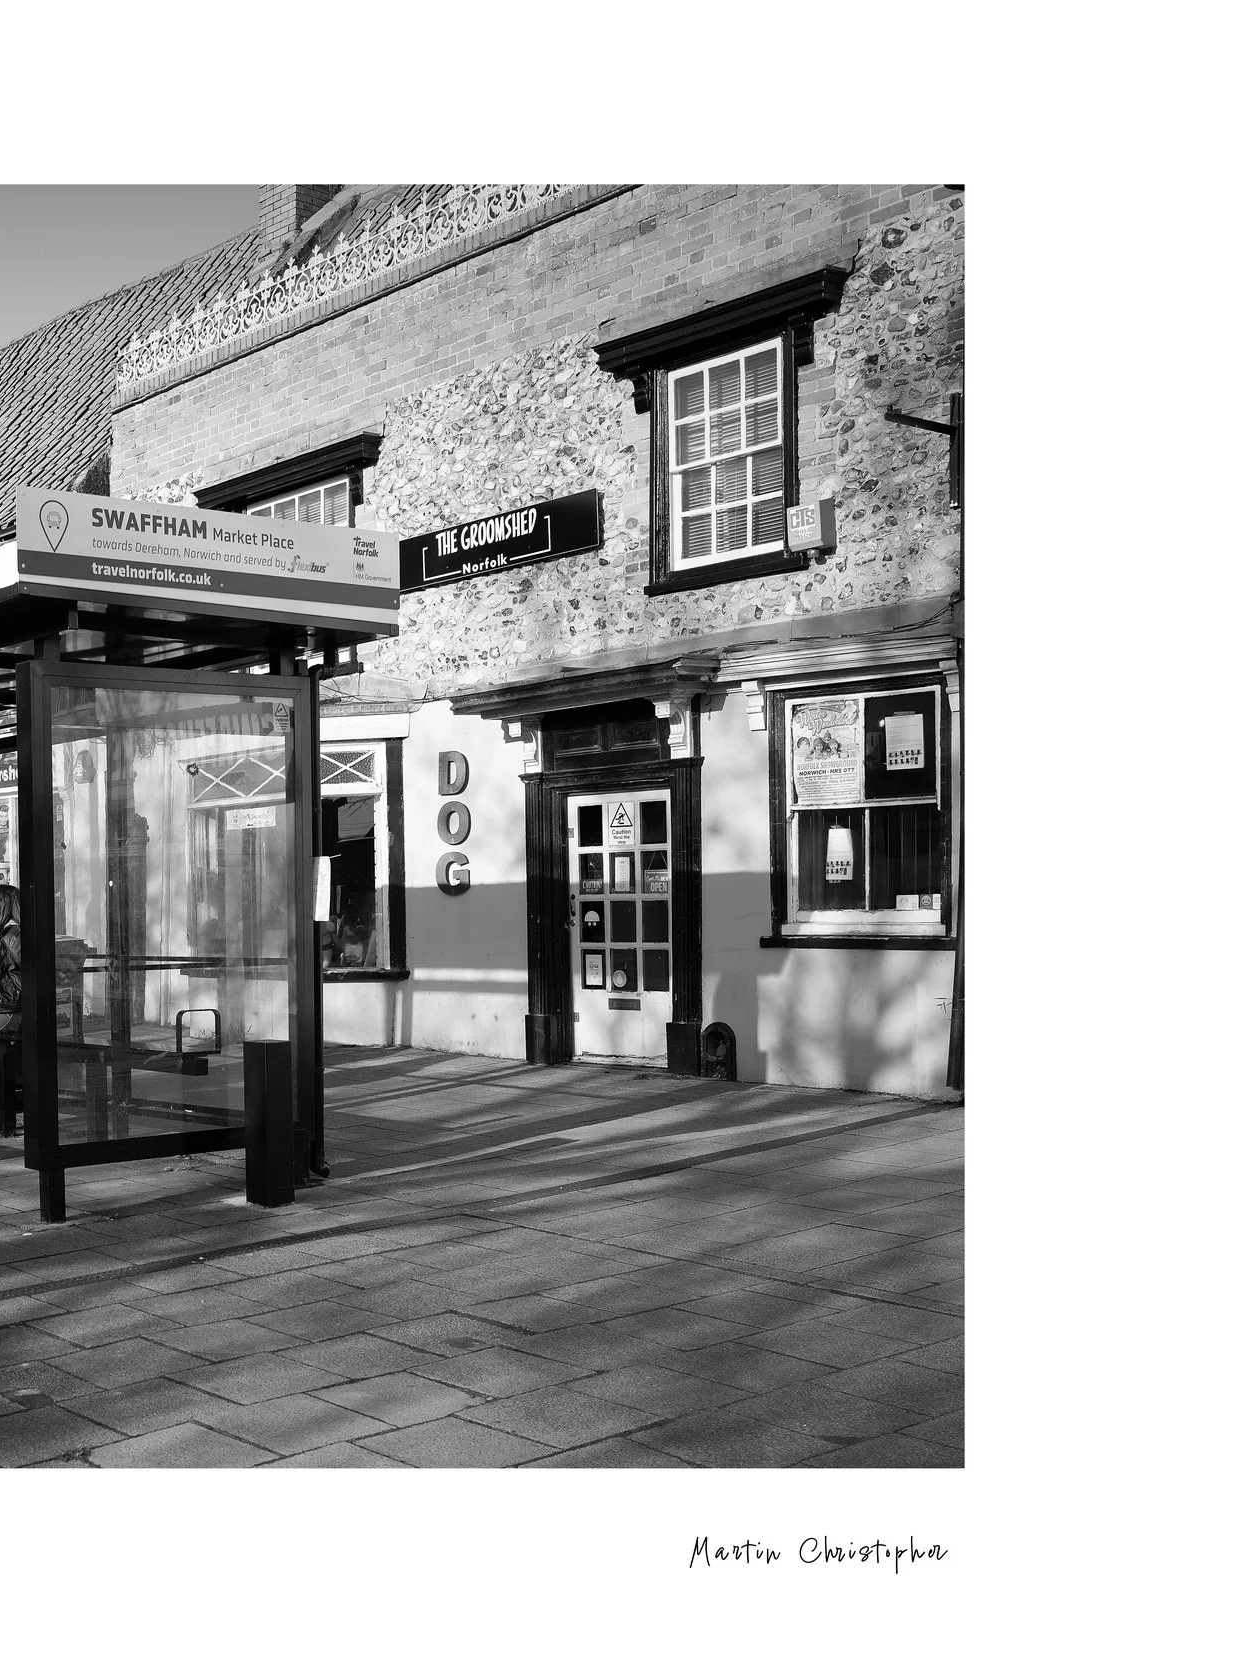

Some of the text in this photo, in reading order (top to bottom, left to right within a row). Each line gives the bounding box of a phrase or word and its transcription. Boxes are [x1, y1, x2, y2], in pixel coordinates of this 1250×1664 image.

[91, 507, 295, 550] SWAFFHAM Market Place
[791, 507, 816, 529] CTS
[352, 536, 376, 549] Travel
[435, 507, 538, 557] THE GROOMSHED
[92, 537, 133, 553] towards
[135, 542, 182, 558] Dereham,
[183, 547, 222, 562] Norwich
[223, 553, 242, 564] and
[243, 555, 274, 567] served
[275, 557, 287, 571] by
[352, 547, 379, 558] Norfolk
[91, 562, 212, 586] travelnorfolk.co.uk
[462, 554, 508, 575] Norfolk
[365, 574, 392, 583] Government
[435, 750, 471, 897] DOG
[650, 882, 668, 892] OPEN
